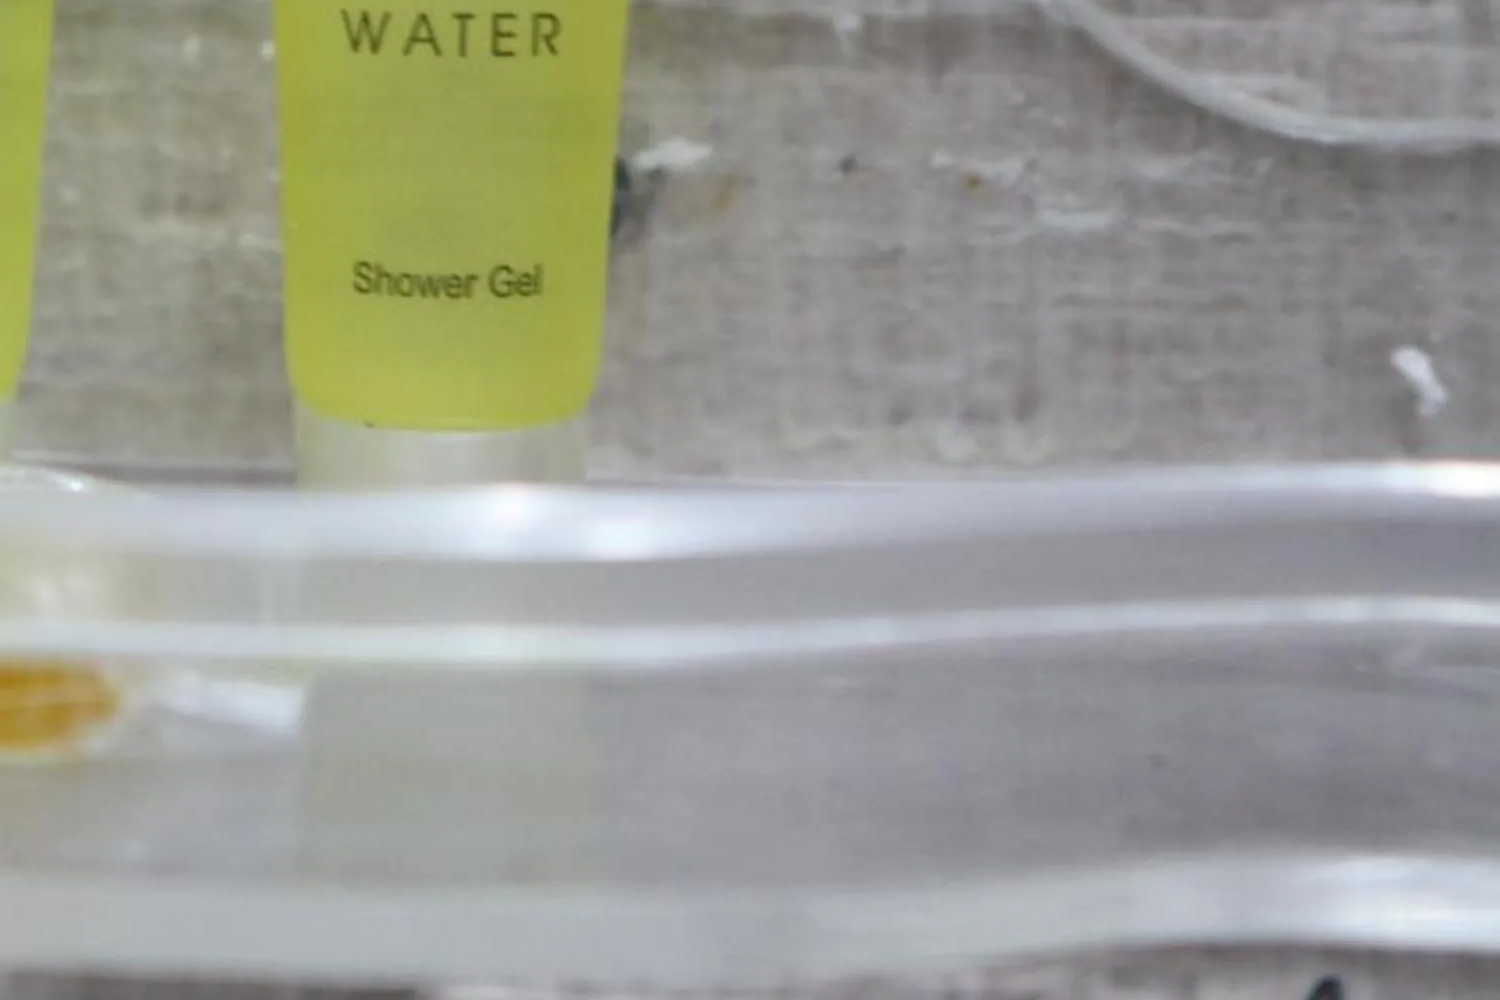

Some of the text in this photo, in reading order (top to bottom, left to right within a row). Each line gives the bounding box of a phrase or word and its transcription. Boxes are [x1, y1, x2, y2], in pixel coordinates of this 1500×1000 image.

[340, 9, 561, 58] WATER
[352, 260, 543, 301] Shower Gel
